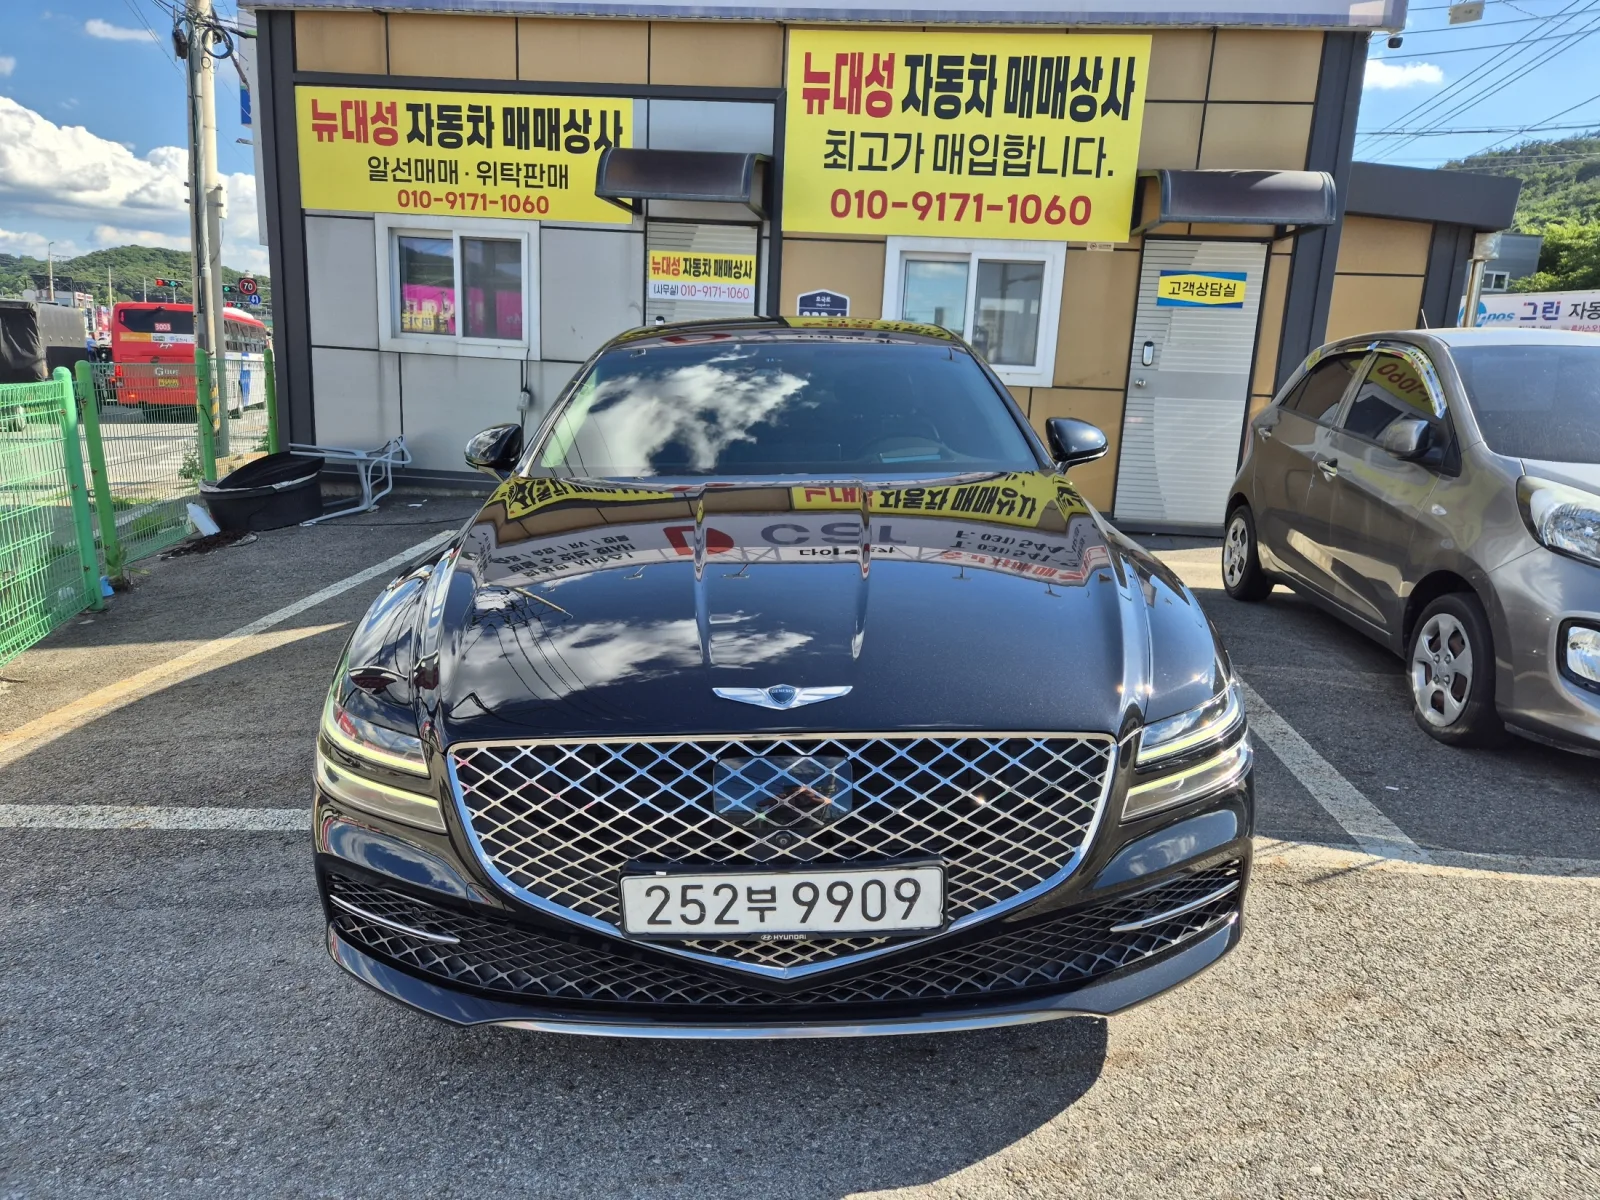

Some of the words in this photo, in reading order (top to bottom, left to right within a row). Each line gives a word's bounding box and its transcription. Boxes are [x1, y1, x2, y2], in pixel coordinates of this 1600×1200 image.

[803, 52, 895, 118] 뉴대성
[902, 53, 998, 120] 자동차
[1004, 56, 1135, 122] 매매상사
[311, 99, 399, 146] 뉴대성
[406, 103, 495, 149] 자동차
[503, 107, 623, 154] 매매상사
[824, 129, 925, 173] 최고가
[932, 133, 1114, 178] 매입합니다.
[398, 189, 550, 215] 010-9171-1060
[831, 188, 1092, 226] 010-9171-1060
[651, 256, 681, 277] 뉴대성
[682, 257, 712, 278] 자동차
[713, 259, 753, 279] 매매상사
[243, 282, 253, 291] 70
[653, 284, 679, 296] (사무실)
[680, 284, 750, 299] 010-9171-1060
[1168, 281, 1237, 298] 고객상담실
[1519, 301, 1561, 321] 그린
[645, 883, 777, 926] 252부
[792, 877, 922, 924] 9909
